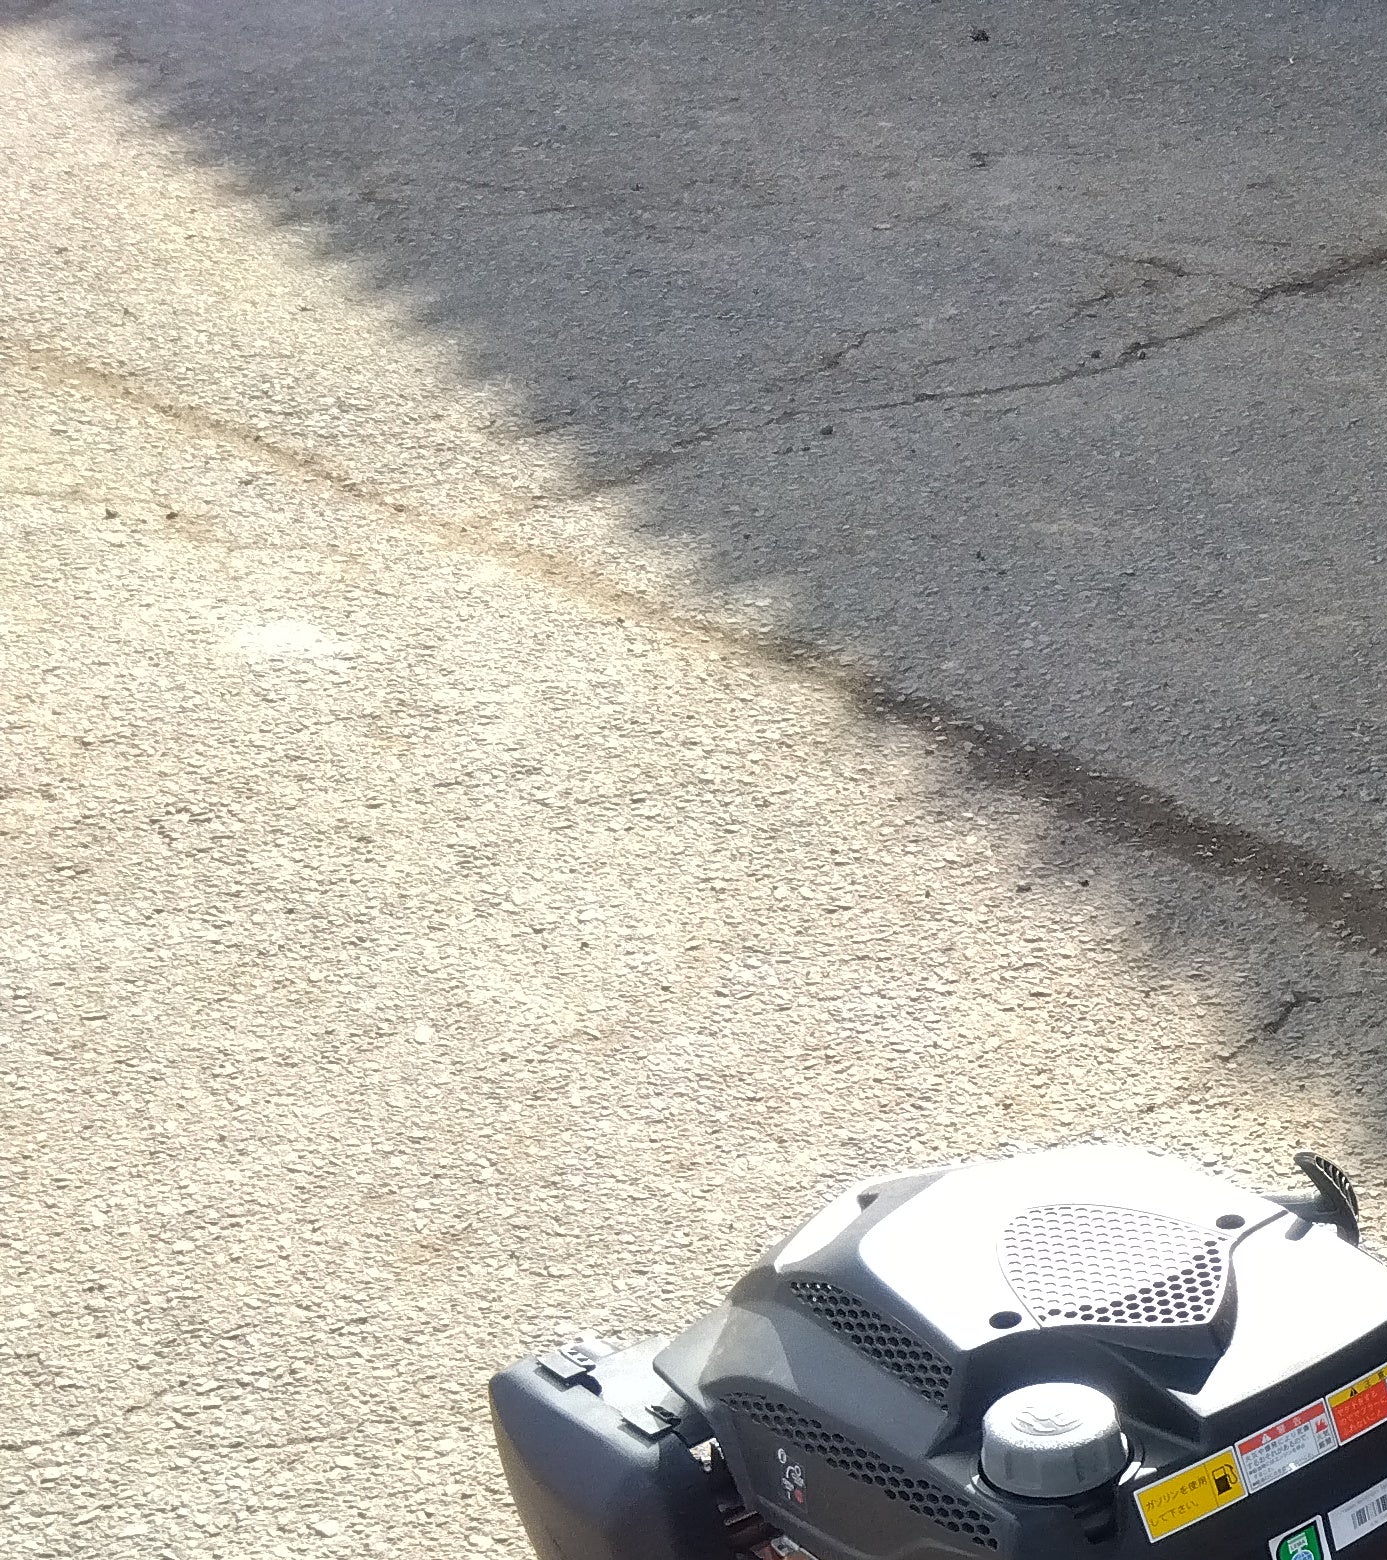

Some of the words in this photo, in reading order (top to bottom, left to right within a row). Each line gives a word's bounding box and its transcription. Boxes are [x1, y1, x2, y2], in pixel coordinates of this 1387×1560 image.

[1146, 1475, 1208, 1511] ガソリンを使用
